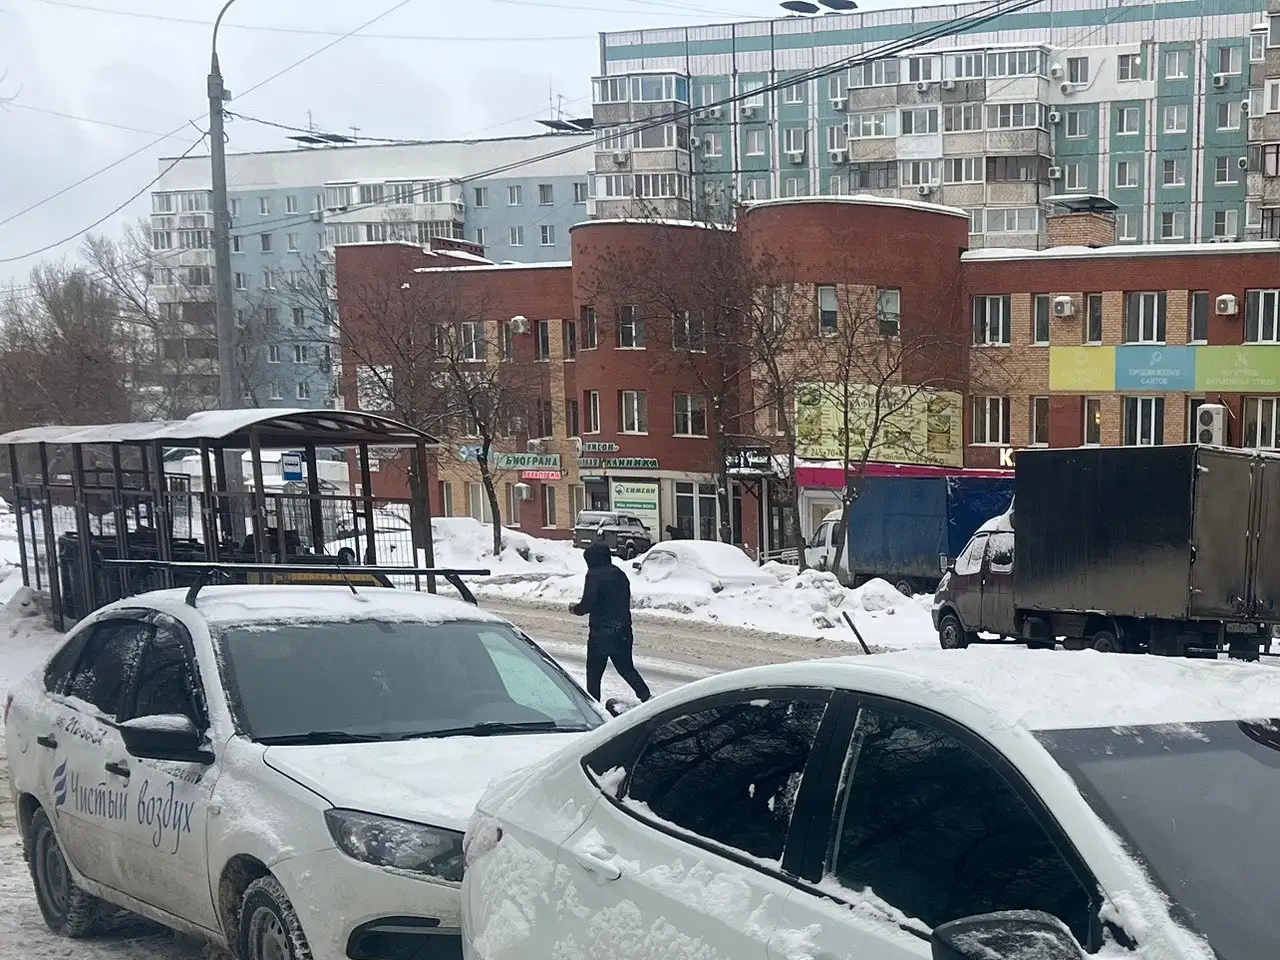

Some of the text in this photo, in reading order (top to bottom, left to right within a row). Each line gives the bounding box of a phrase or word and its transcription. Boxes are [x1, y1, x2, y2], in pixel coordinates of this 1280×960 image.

[505, 455, 558, 466] БИОГРАНД
[71, 771, 196, 855] Чистый воздух
